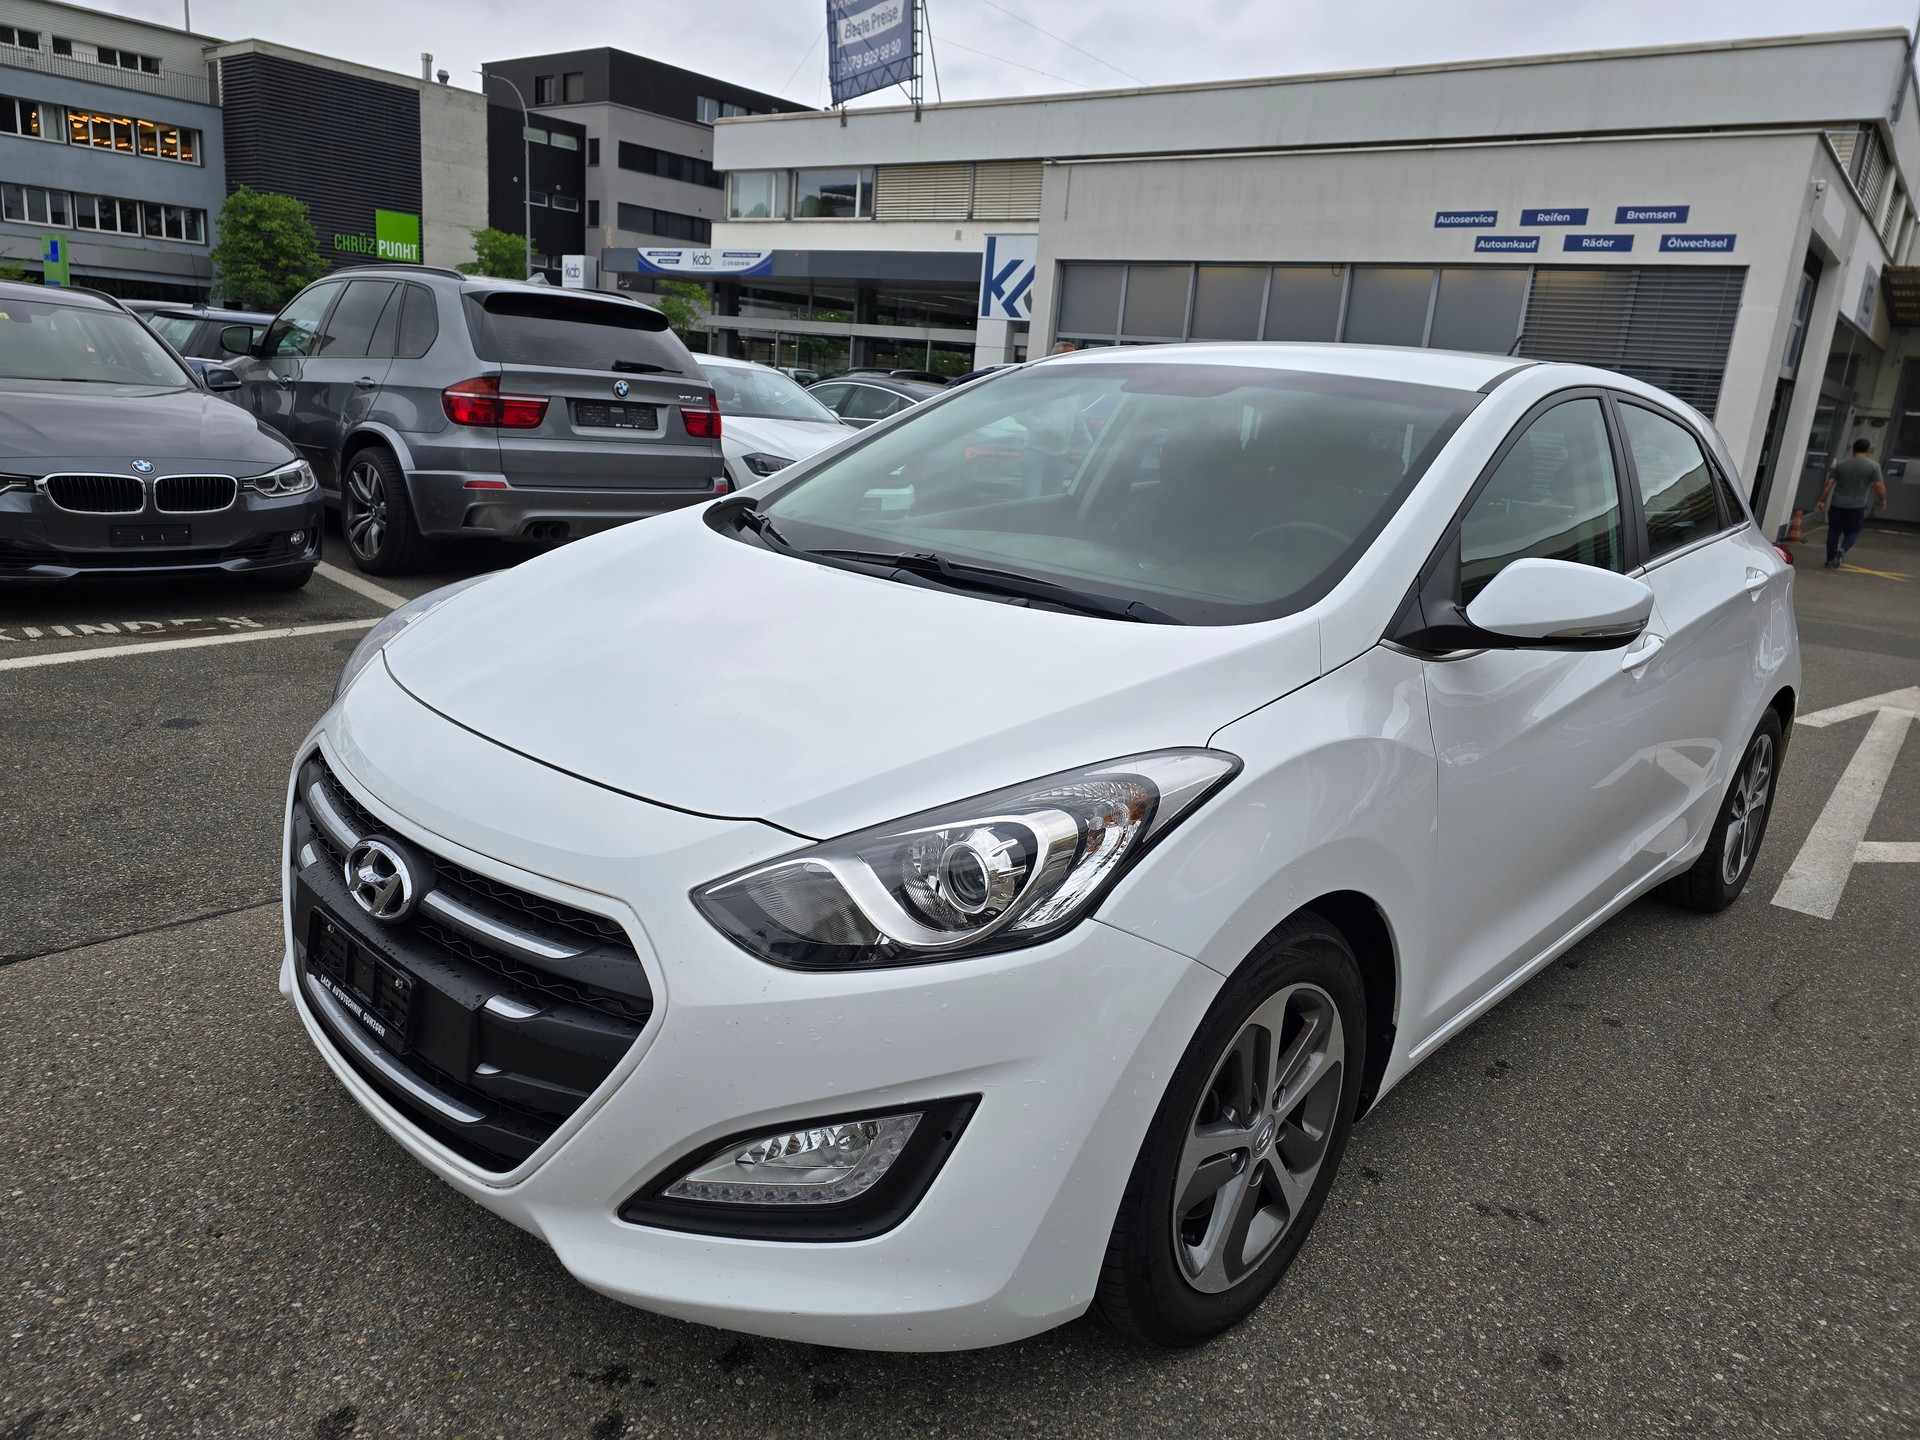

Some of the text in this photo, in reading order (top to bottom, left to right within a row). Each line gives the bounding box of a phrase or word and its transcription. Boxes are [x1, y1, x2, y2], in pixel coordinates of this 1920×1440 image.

[845, 6, 898, 39] Beste Preise
[1437, 214, 1495, 224] Autoservice
[1537, 212, 1571, 222] Reifen
[1626, 210, 1677, 220] Bremsen
[334, 232, 417, 260] CHRÜZ PUNKT
[1477, 239, 1537, 249] Autoankauf
[1582, 238, 1615, 248] Räder
[1667, 236, 1728, 249] Ölwechsel
[692, 251, 712, 266] kab
